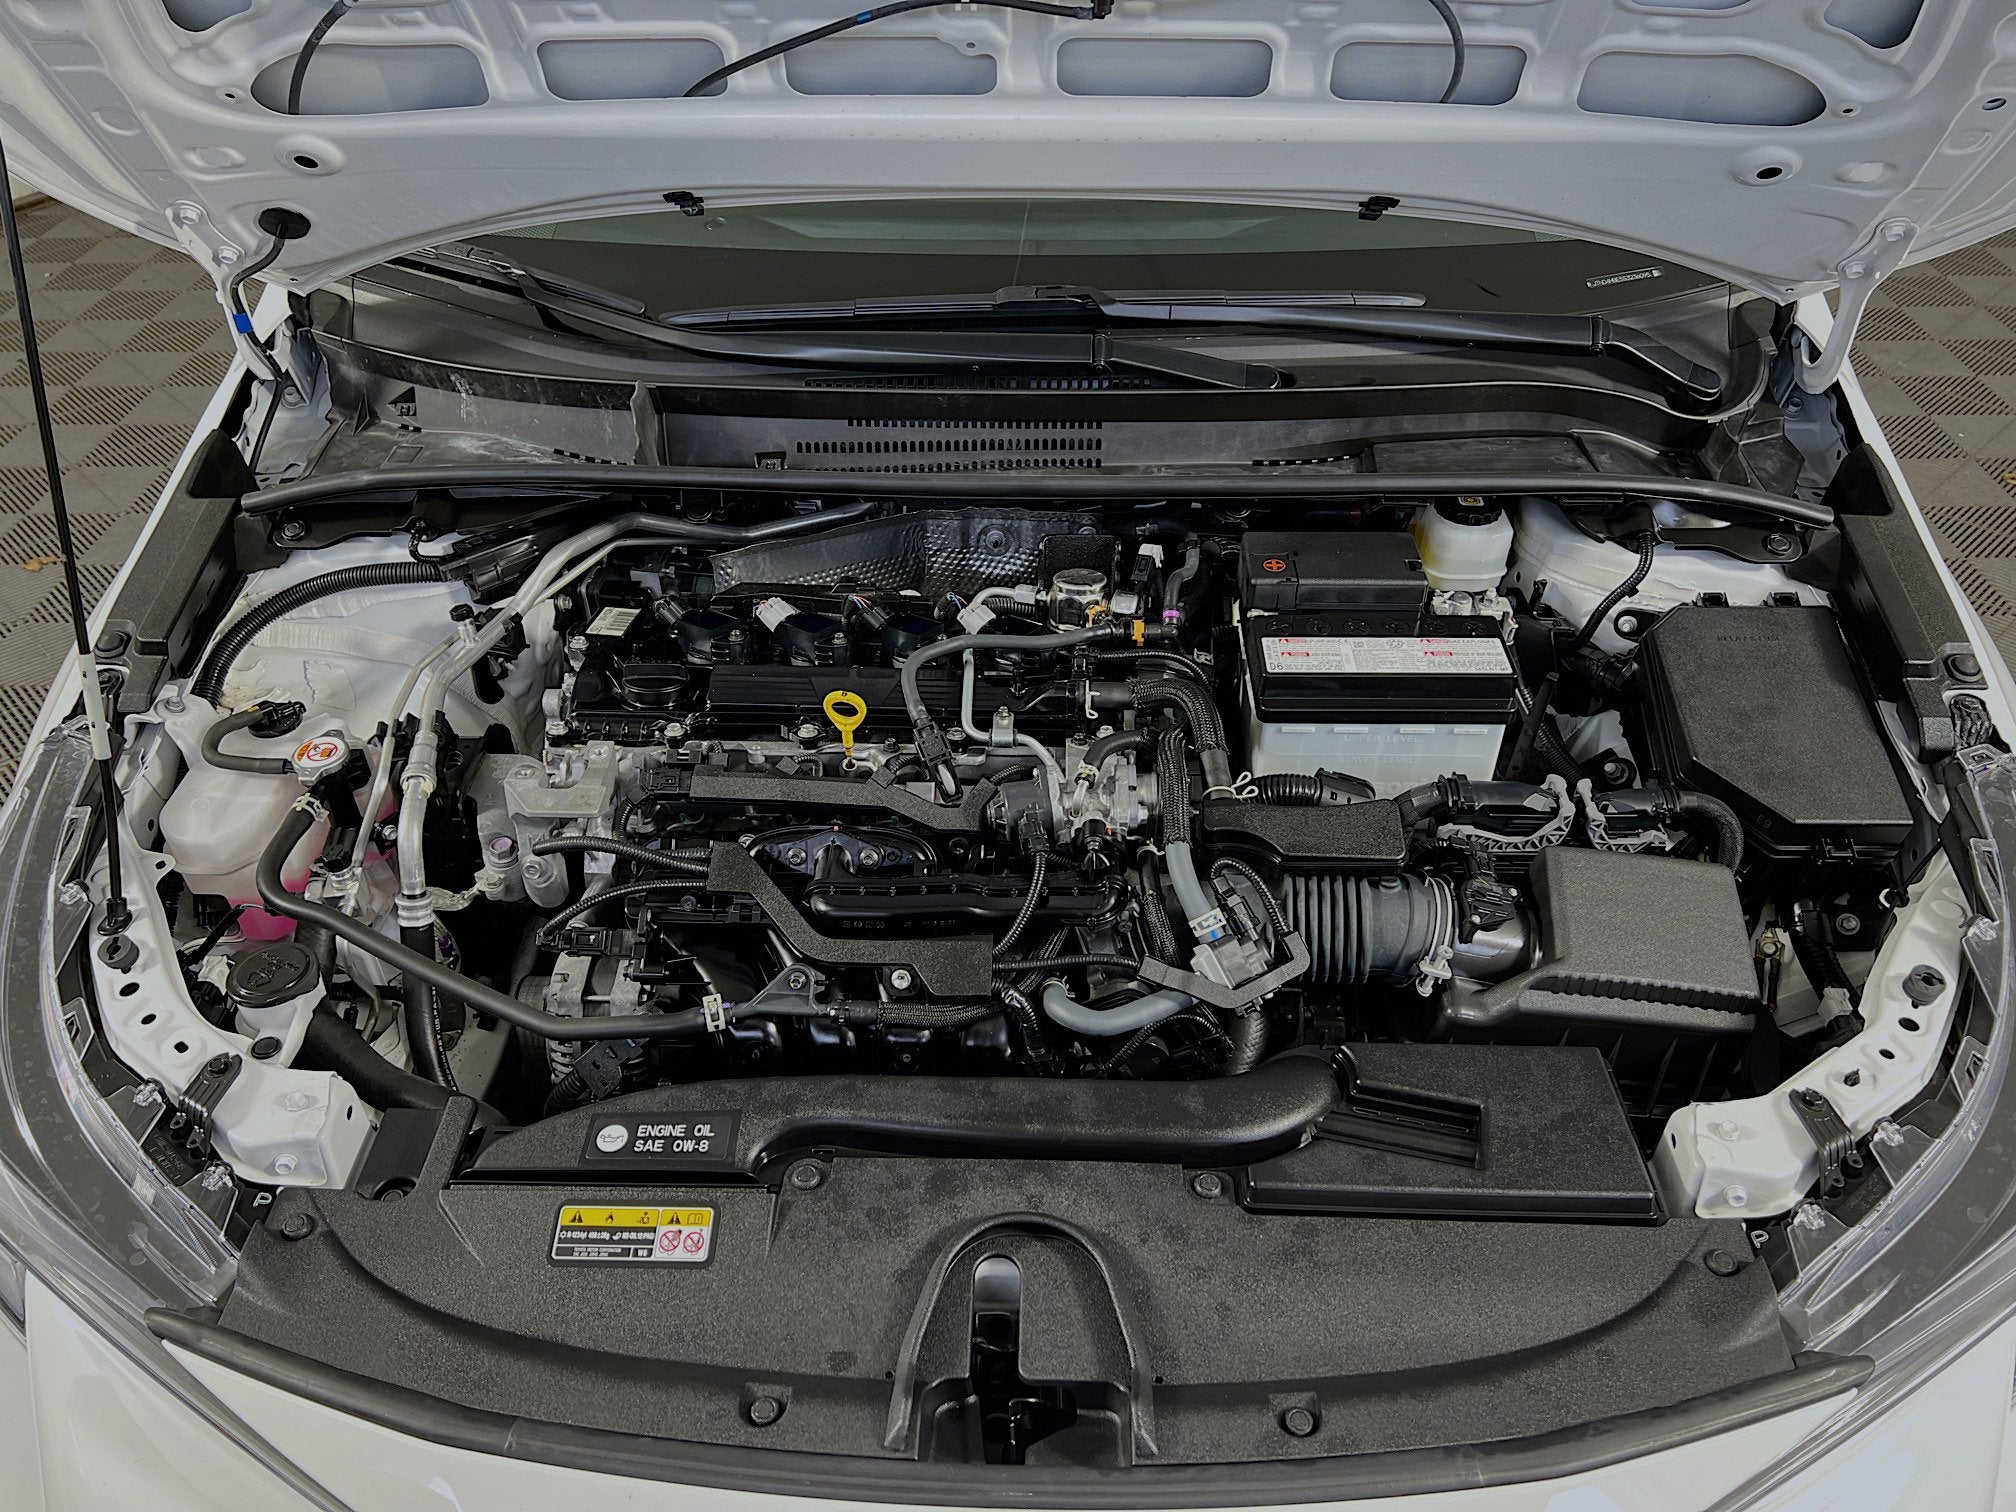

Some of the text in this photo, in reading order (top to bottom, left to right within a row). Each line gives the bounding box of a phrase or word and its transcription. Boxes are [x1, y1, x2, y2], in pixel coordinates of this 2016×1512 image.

[1270, 662, 1284, 671] D6
[1386, 735, 1424, 743] LEVEL
[636, 1124, 715, 1137] ENGINE OIL
[633, 1139, 665, 1152] SAE
